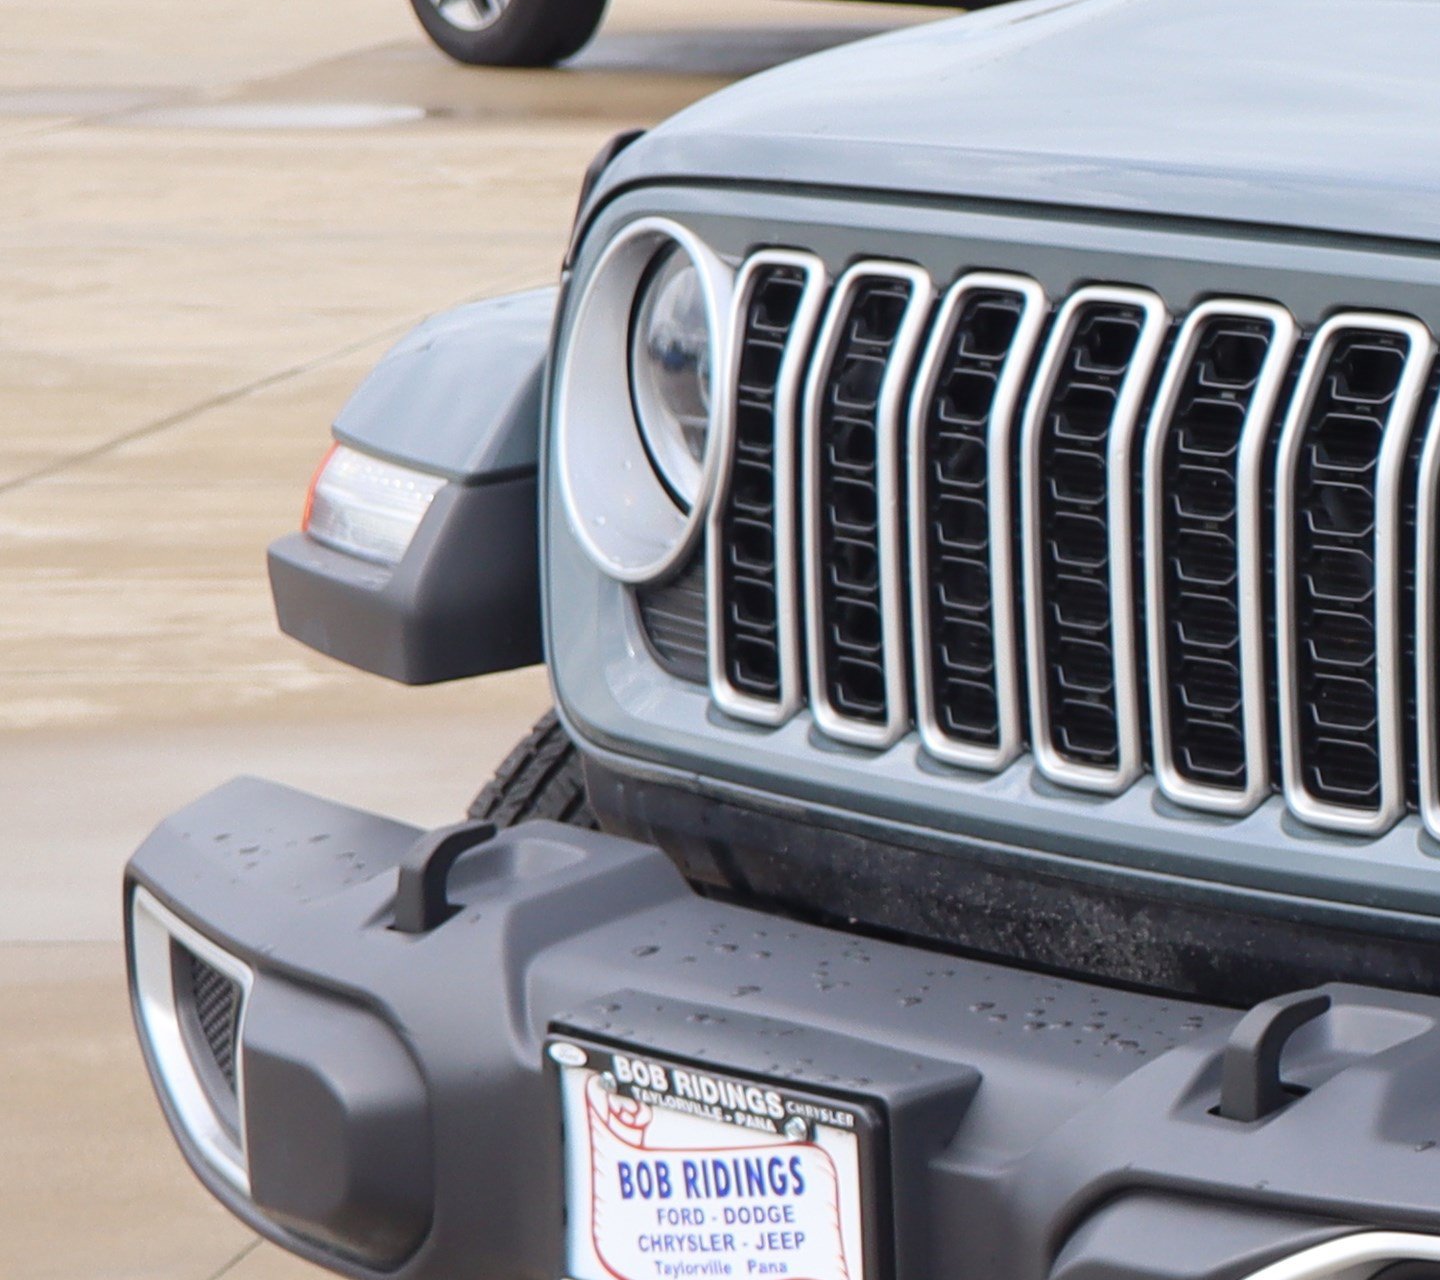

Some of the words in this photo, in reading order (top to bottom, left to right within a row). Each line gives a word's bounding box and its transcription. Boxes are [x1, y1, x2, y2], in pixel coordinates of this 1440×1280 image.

[612, 1053, 669, 1092] BOB
[671, 1069, 785, 1120] RIDINGS
[631, 1086, 723, 1122] TAYLORVILLE
[734, 1111, 778, 1134] PANA
[785, 1100, 855, 1128] CHRYSLER
[617, 1159, 673, 1200] BOB
[681, 1154, 806, 1199] RIDINGS
[656, 1207, 705, 1226] FORD
[723, 1204, 796, 1225] DODGE
[637, 1232, 736, 1253] CHRYSLER
[755, 1230, 806, 1251] JEEP
[654, 1259, 733, 1279] Taylorville
[746, 1259, 788, 1274] Pana
